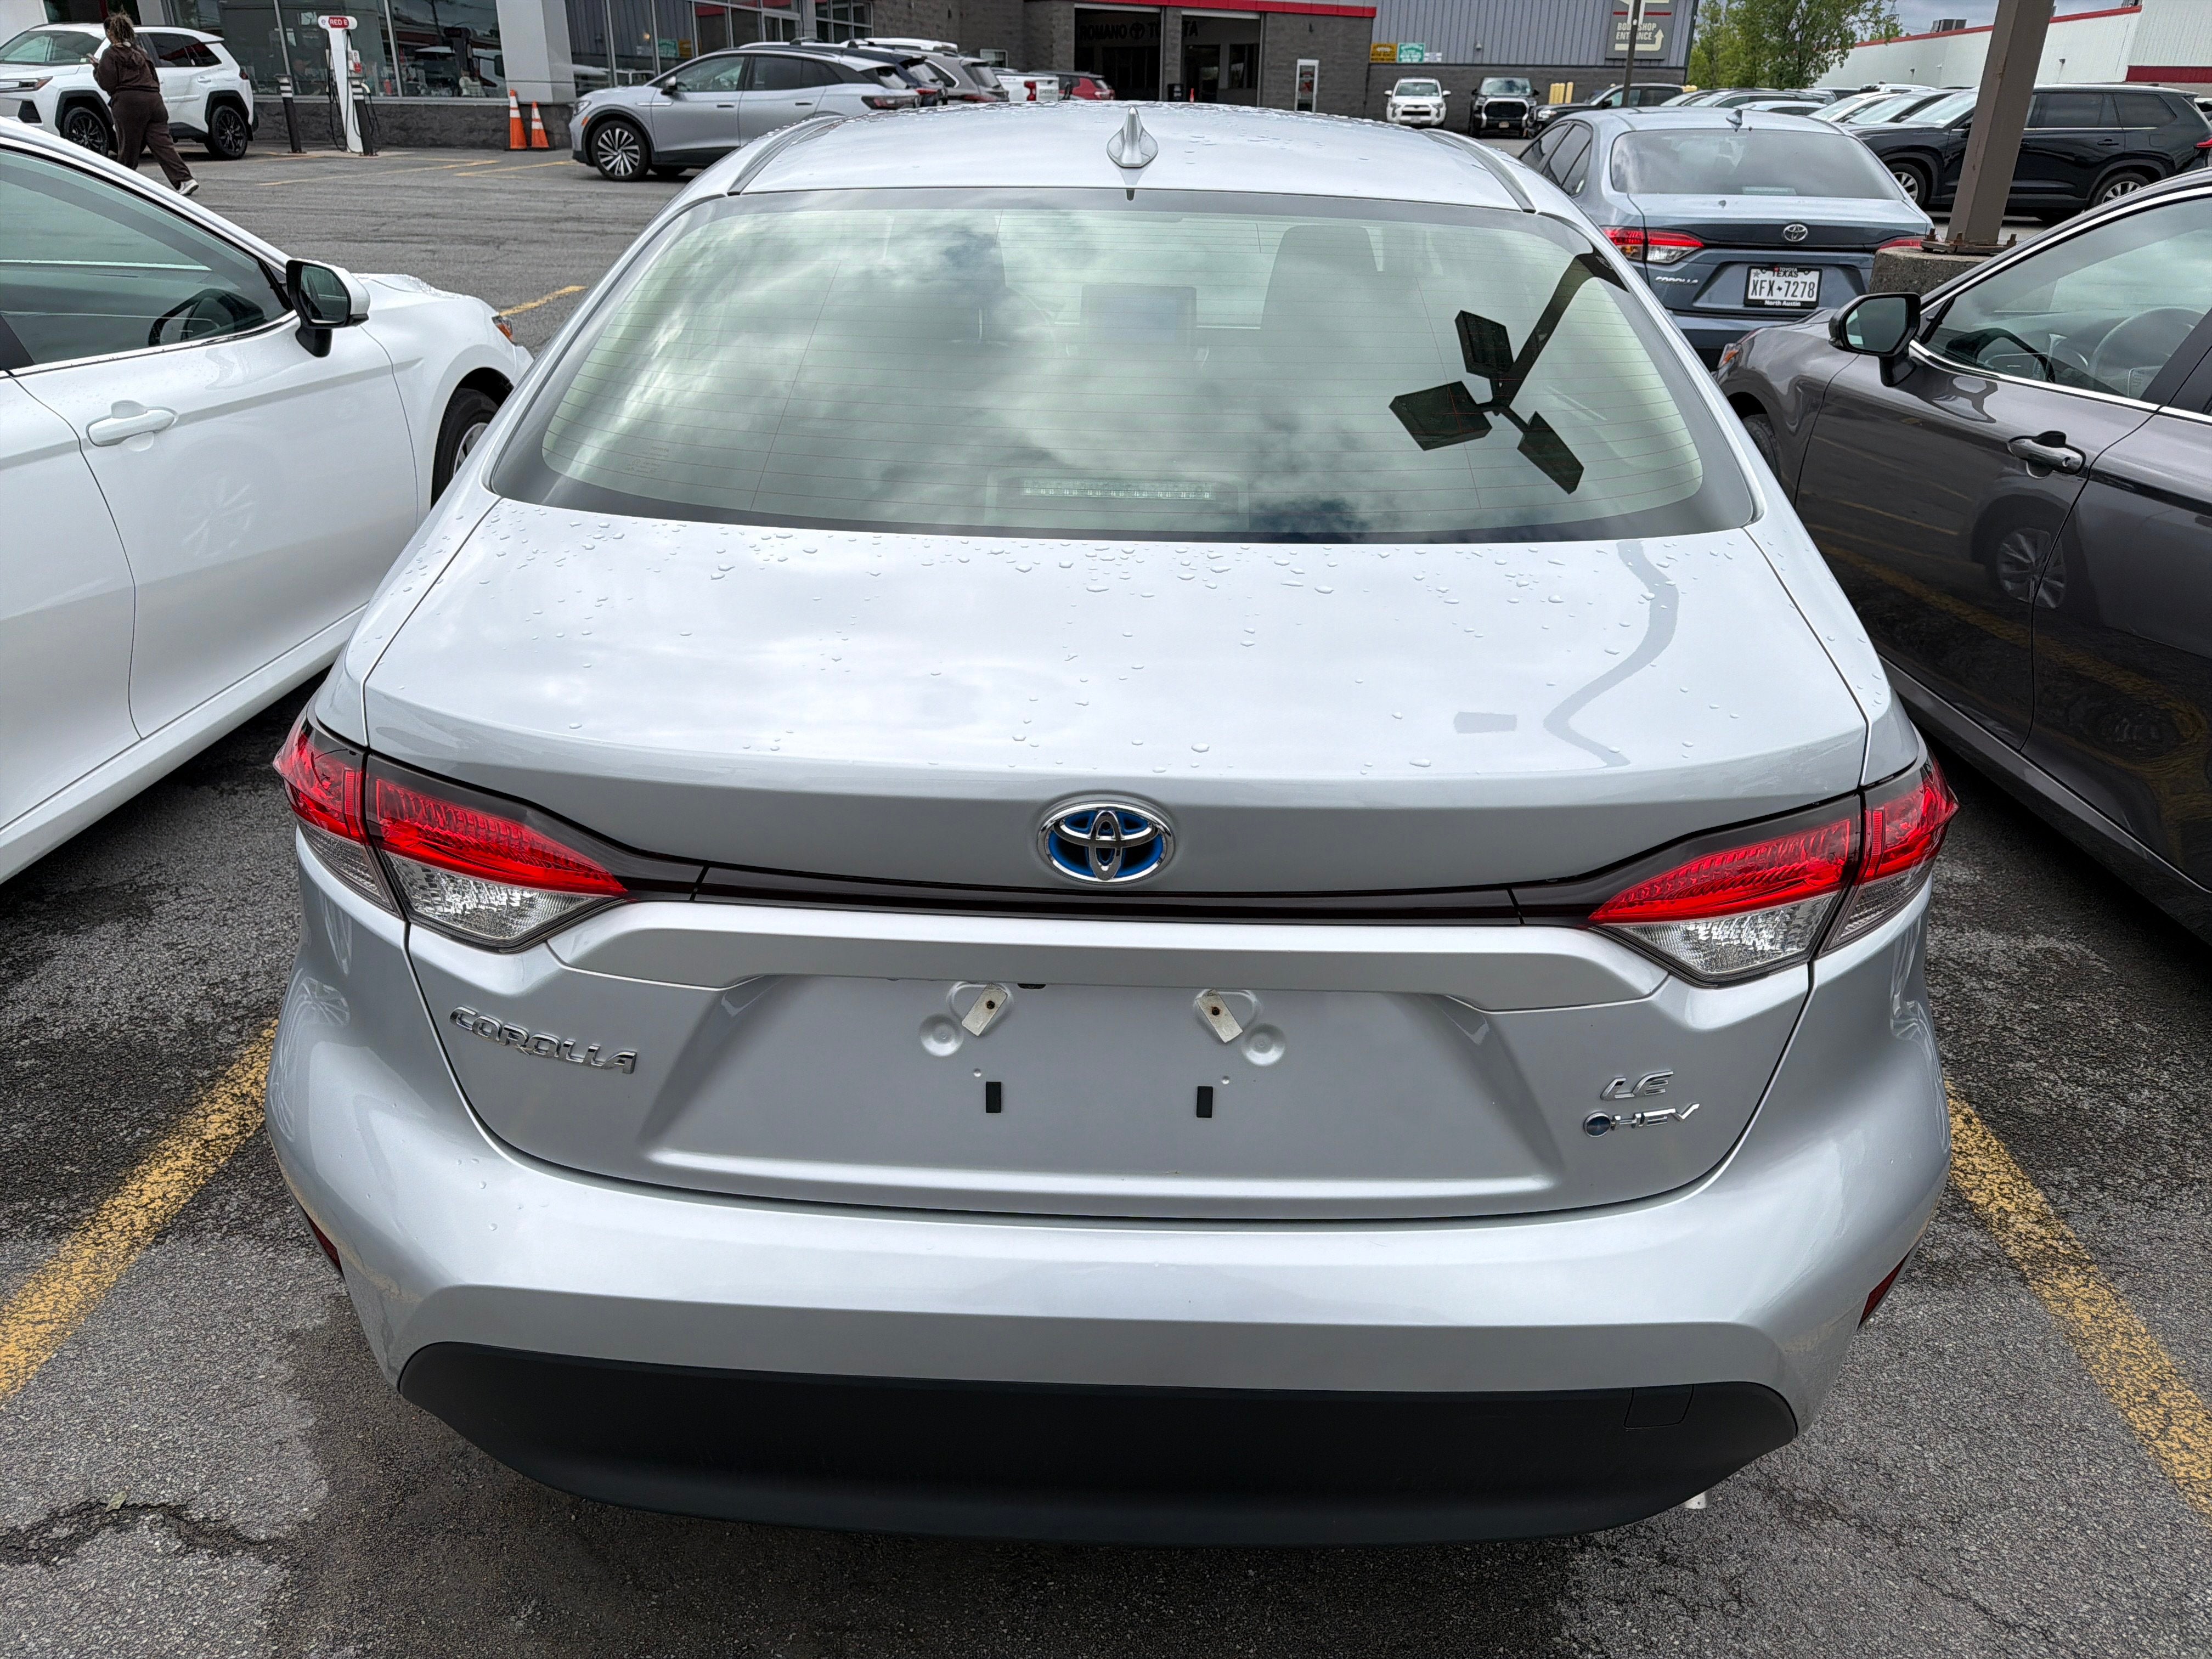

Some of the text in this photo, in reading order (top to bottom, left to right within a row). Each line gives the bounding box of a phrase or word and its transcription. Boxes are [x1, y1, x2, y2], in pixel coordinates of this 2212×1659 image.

[1616, 31, 1652, 40] ENTNCE
[1617, 22, 1657, 31] BOD SHOP
[1751, 279, 1815, 298] XFX 7278
[449, 1006, 637, 1074] COROLLA
[1600, 1070, 1674, 1101] LE
